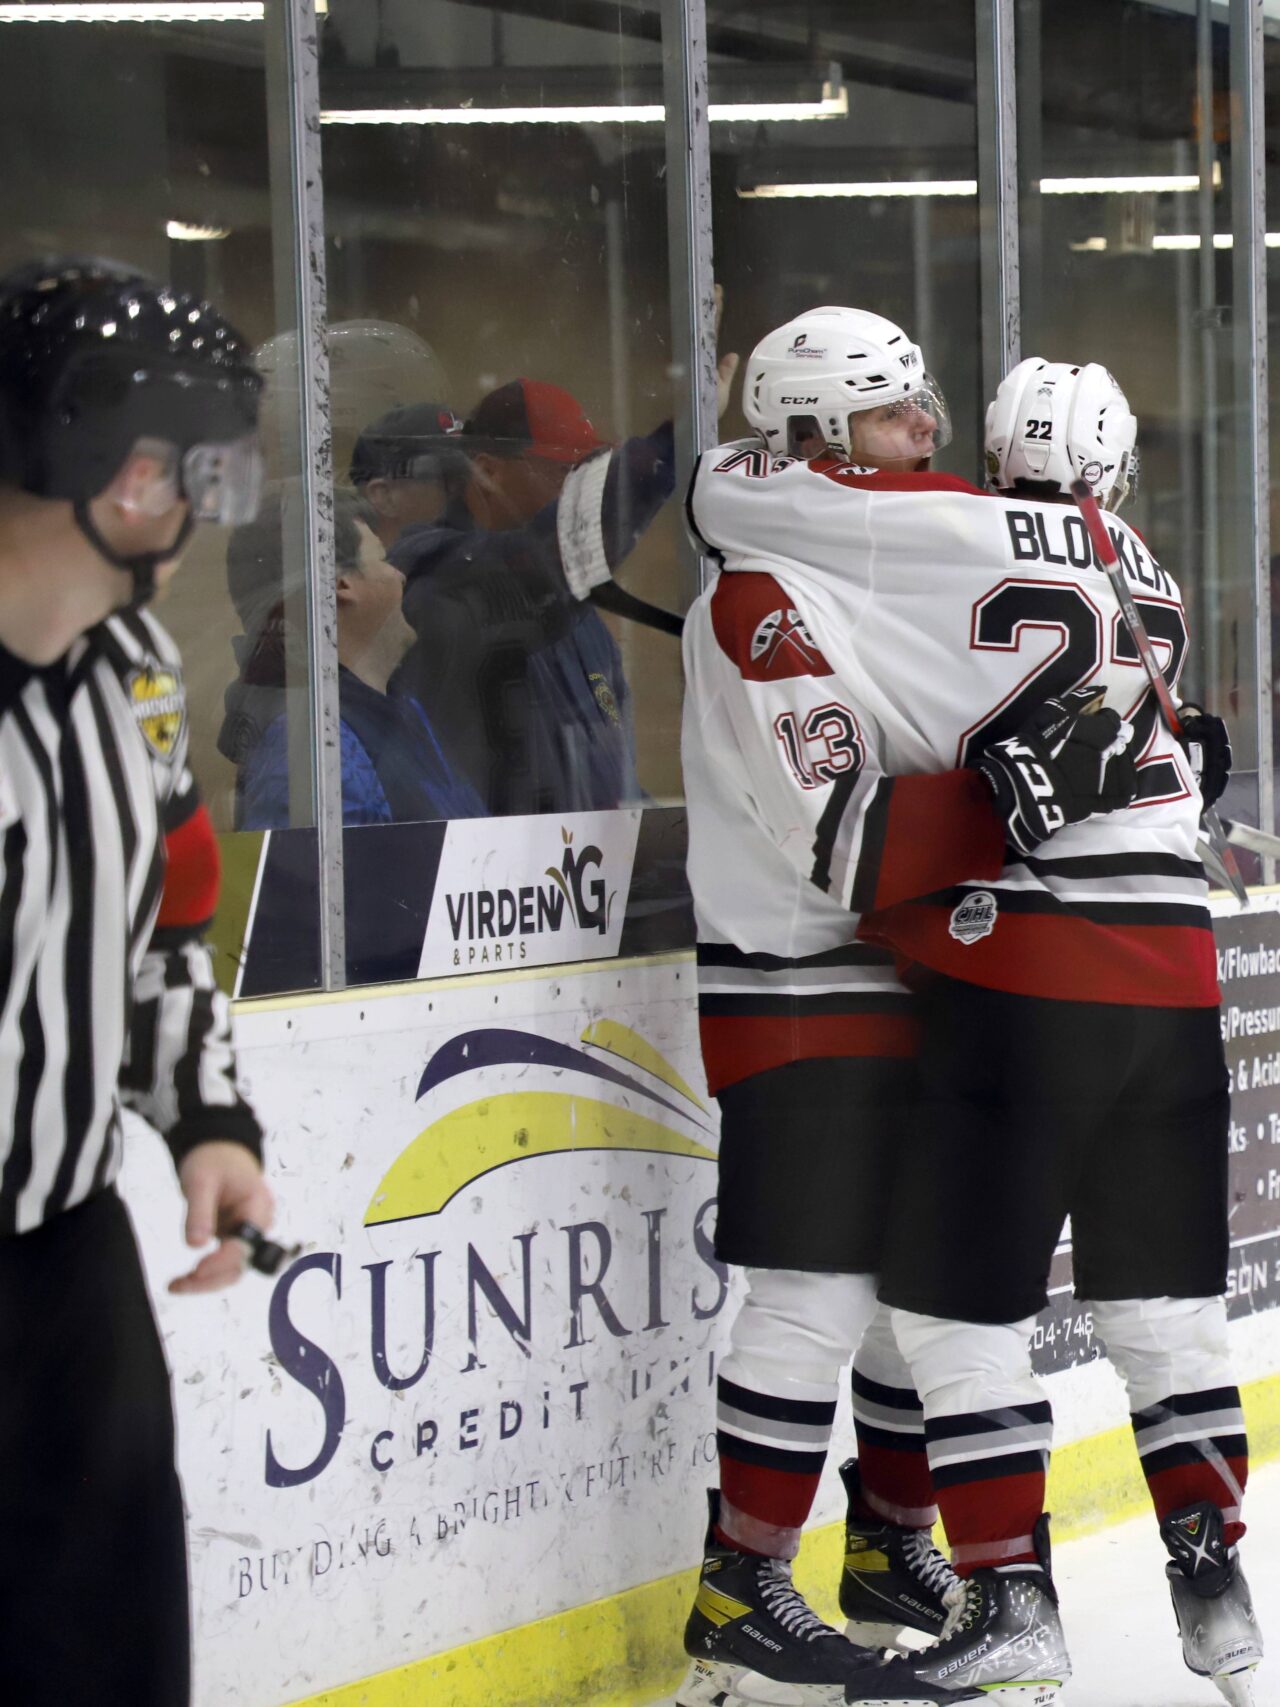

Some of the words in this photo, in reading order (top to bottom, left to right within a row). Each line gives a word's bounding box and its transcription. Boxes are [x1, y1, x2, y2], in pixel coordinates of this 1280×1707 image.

[780, 396, 819, 405] CCM
[1025, 419, 1053, 440] 22
[1005, 510, 1172, 597] BLOKER
[774, 702, 867, 789] 13
[995, 736, 1066, 834] CCM
[468, 940, 527, 964] PARTS
[1237, 1060, 1249, 1091] &
[1252, 1052, 1280, 1088] Acid
[370, 1382, 588, 1472] CREDIT
